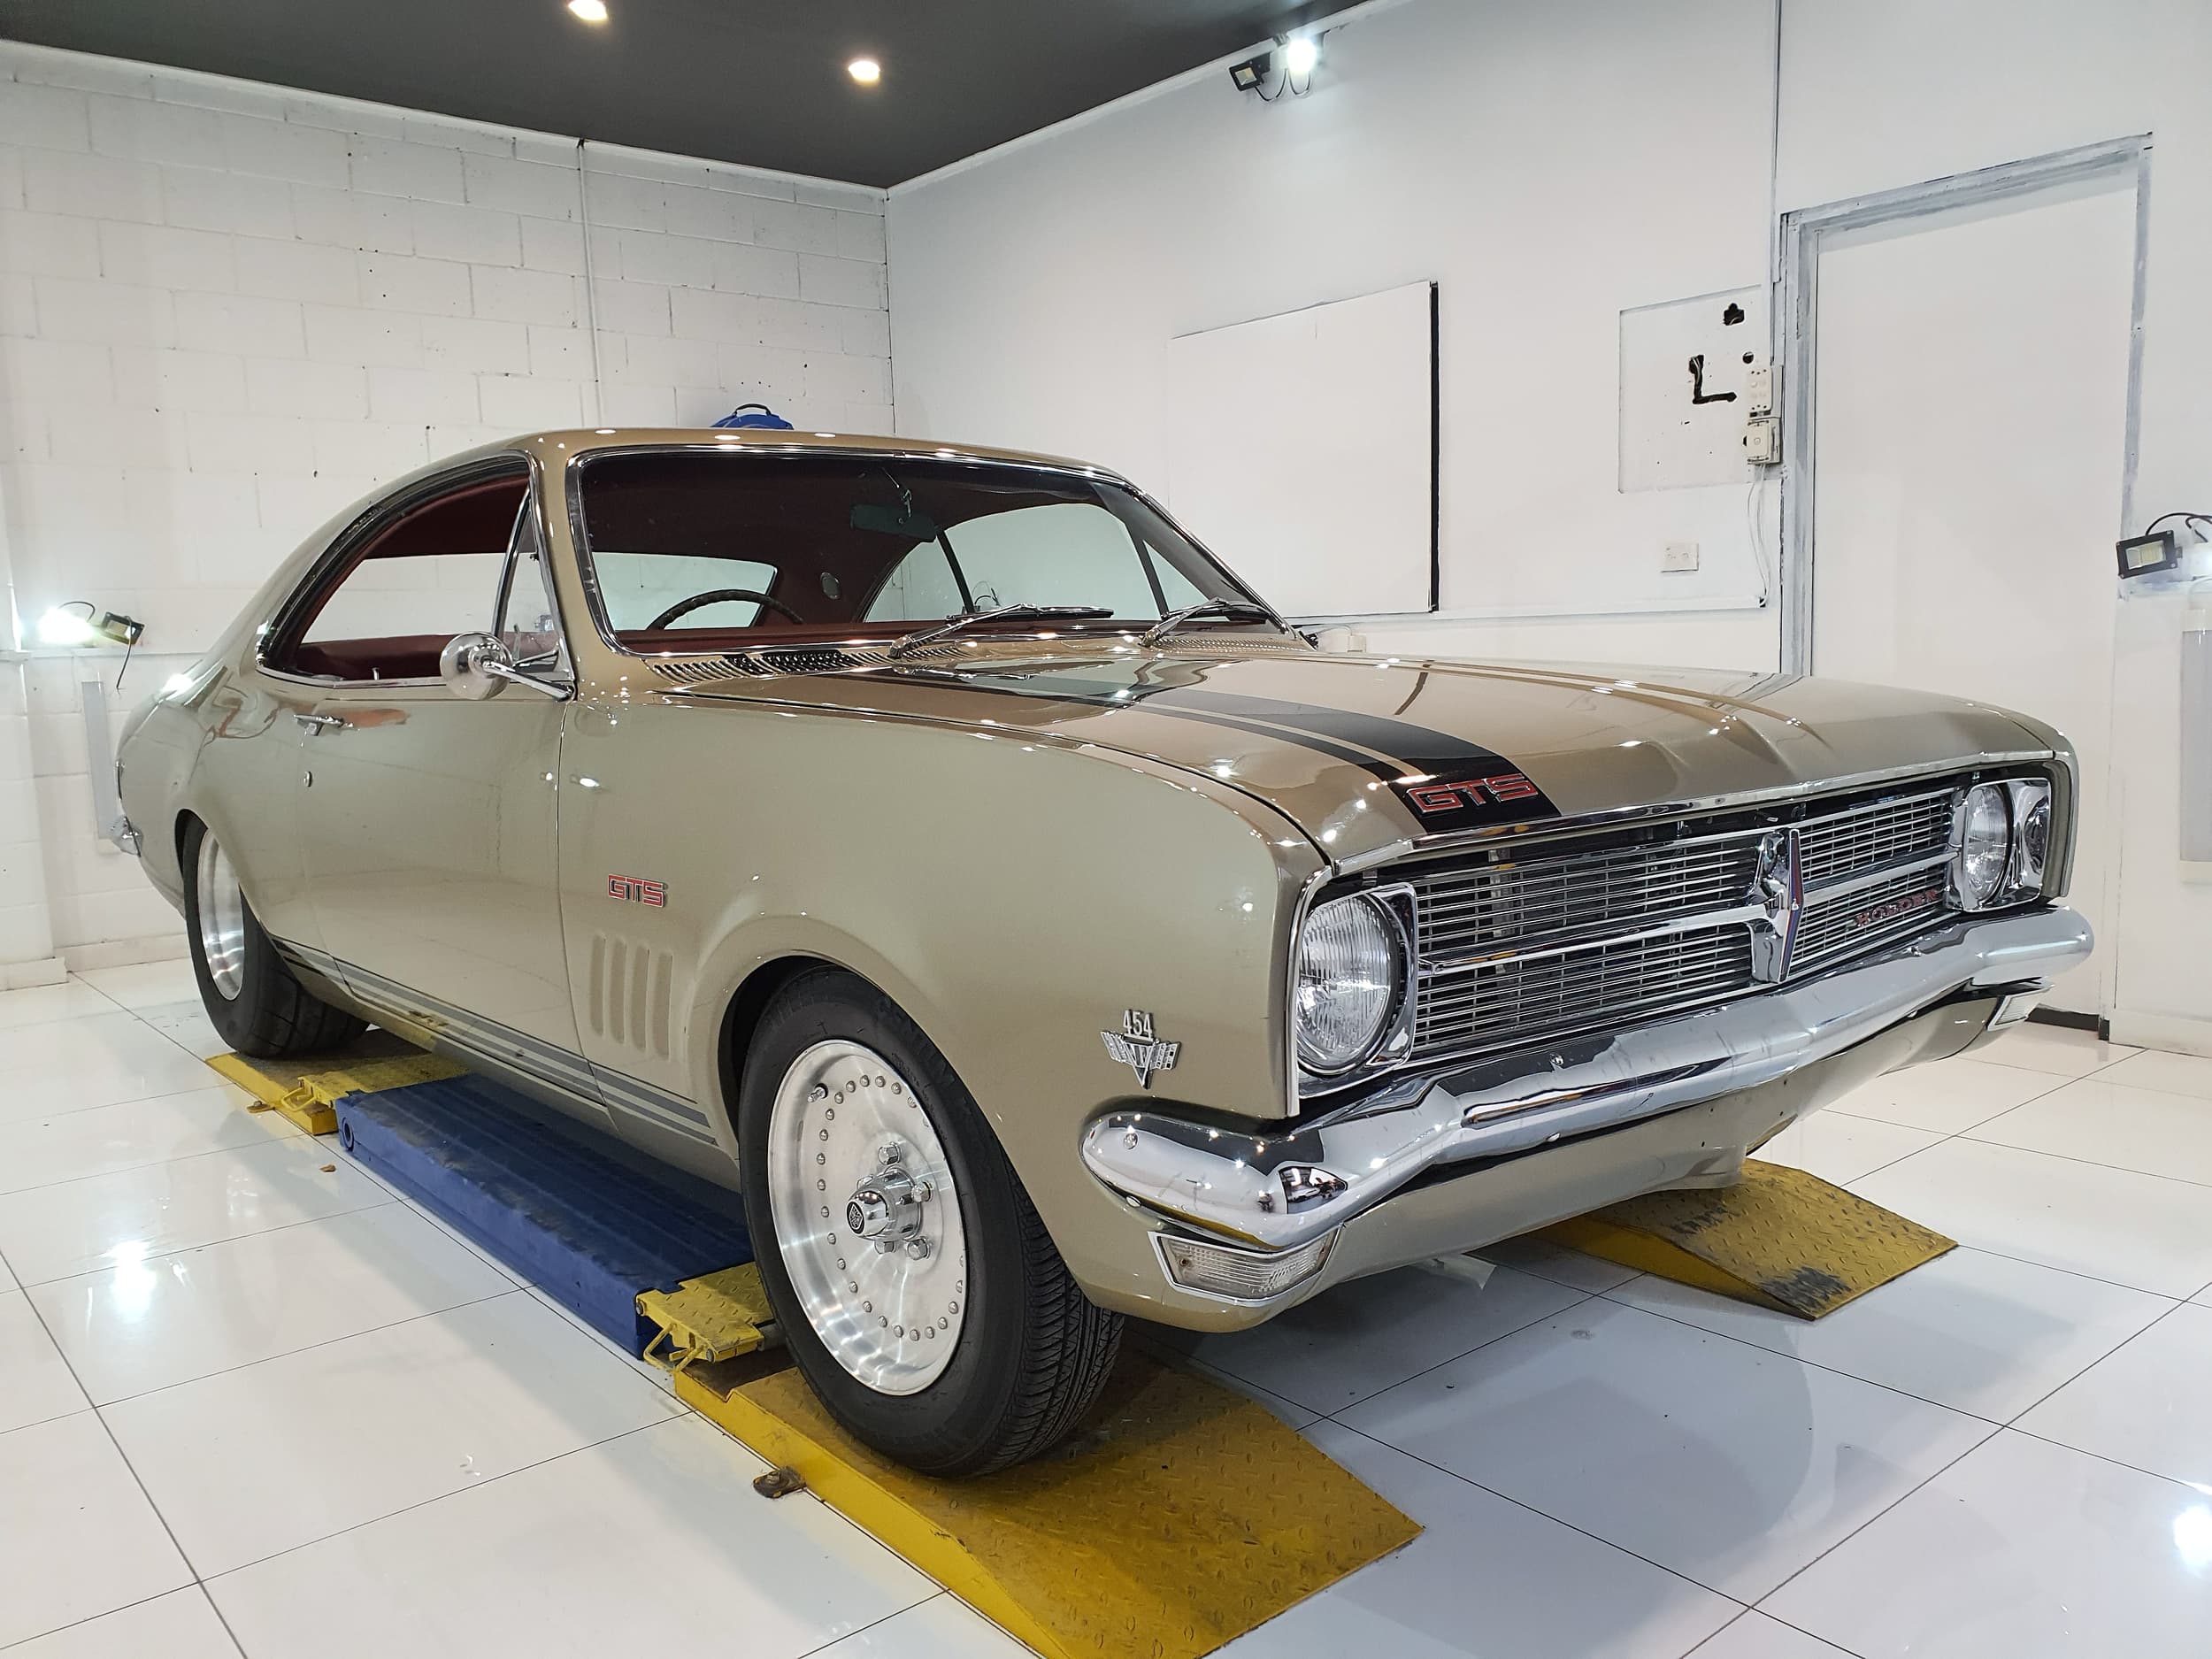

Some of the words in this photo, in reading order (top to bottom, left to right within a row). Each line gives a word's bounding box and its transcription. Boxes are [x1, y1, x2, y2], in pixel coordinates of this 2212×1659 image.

[1406, 773, 1539, 813] GTS
[608, 874, 664, 908] GTS
[1123, 1010, 1153, 1038] 454
